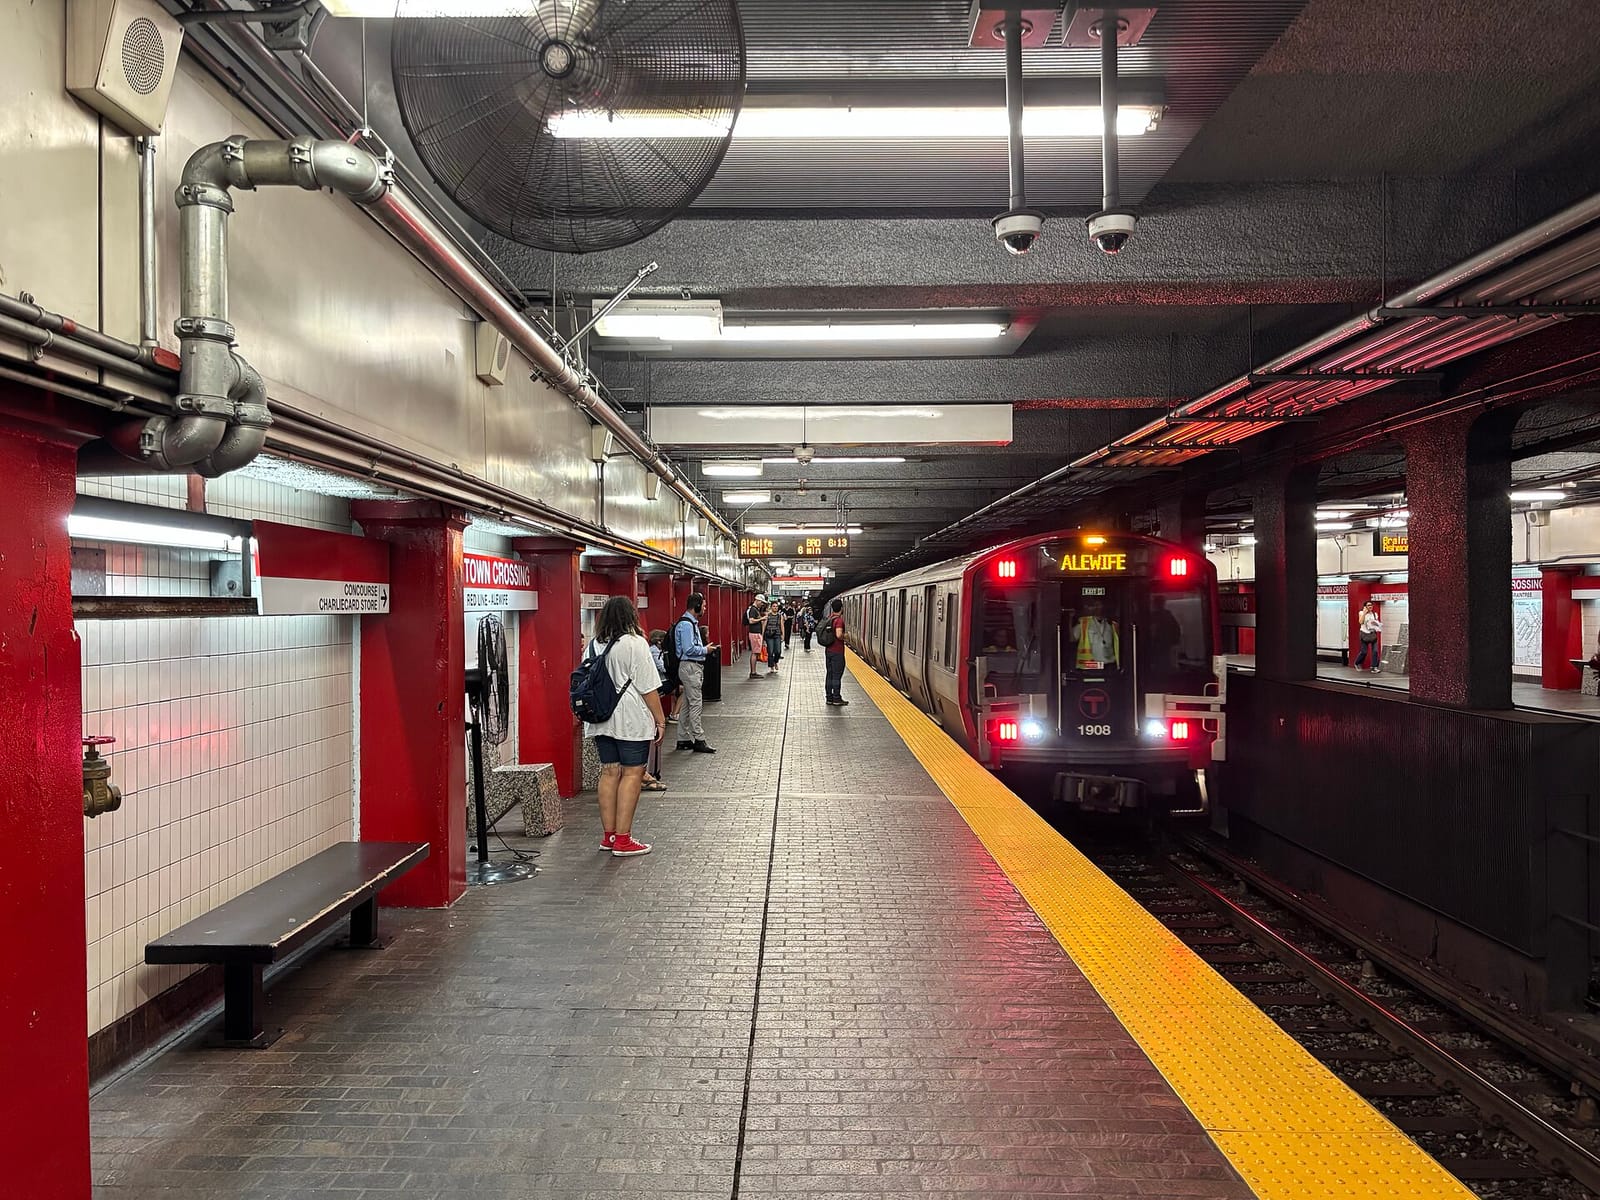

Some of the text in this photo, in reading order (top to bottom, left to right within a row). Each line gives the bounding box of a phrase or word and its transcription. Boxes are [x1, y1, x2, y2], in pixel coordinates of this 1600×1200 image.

[1061, 554, 1126, 570] ALEWIFE
[464, 558, 530, 587] TOWN CROSSING
[344, 583, 378, 597] CONCOURSE
[319, 598, 378, 611] CHARLIECARD STORE
[1077, 724, 1112, 736] 1908
